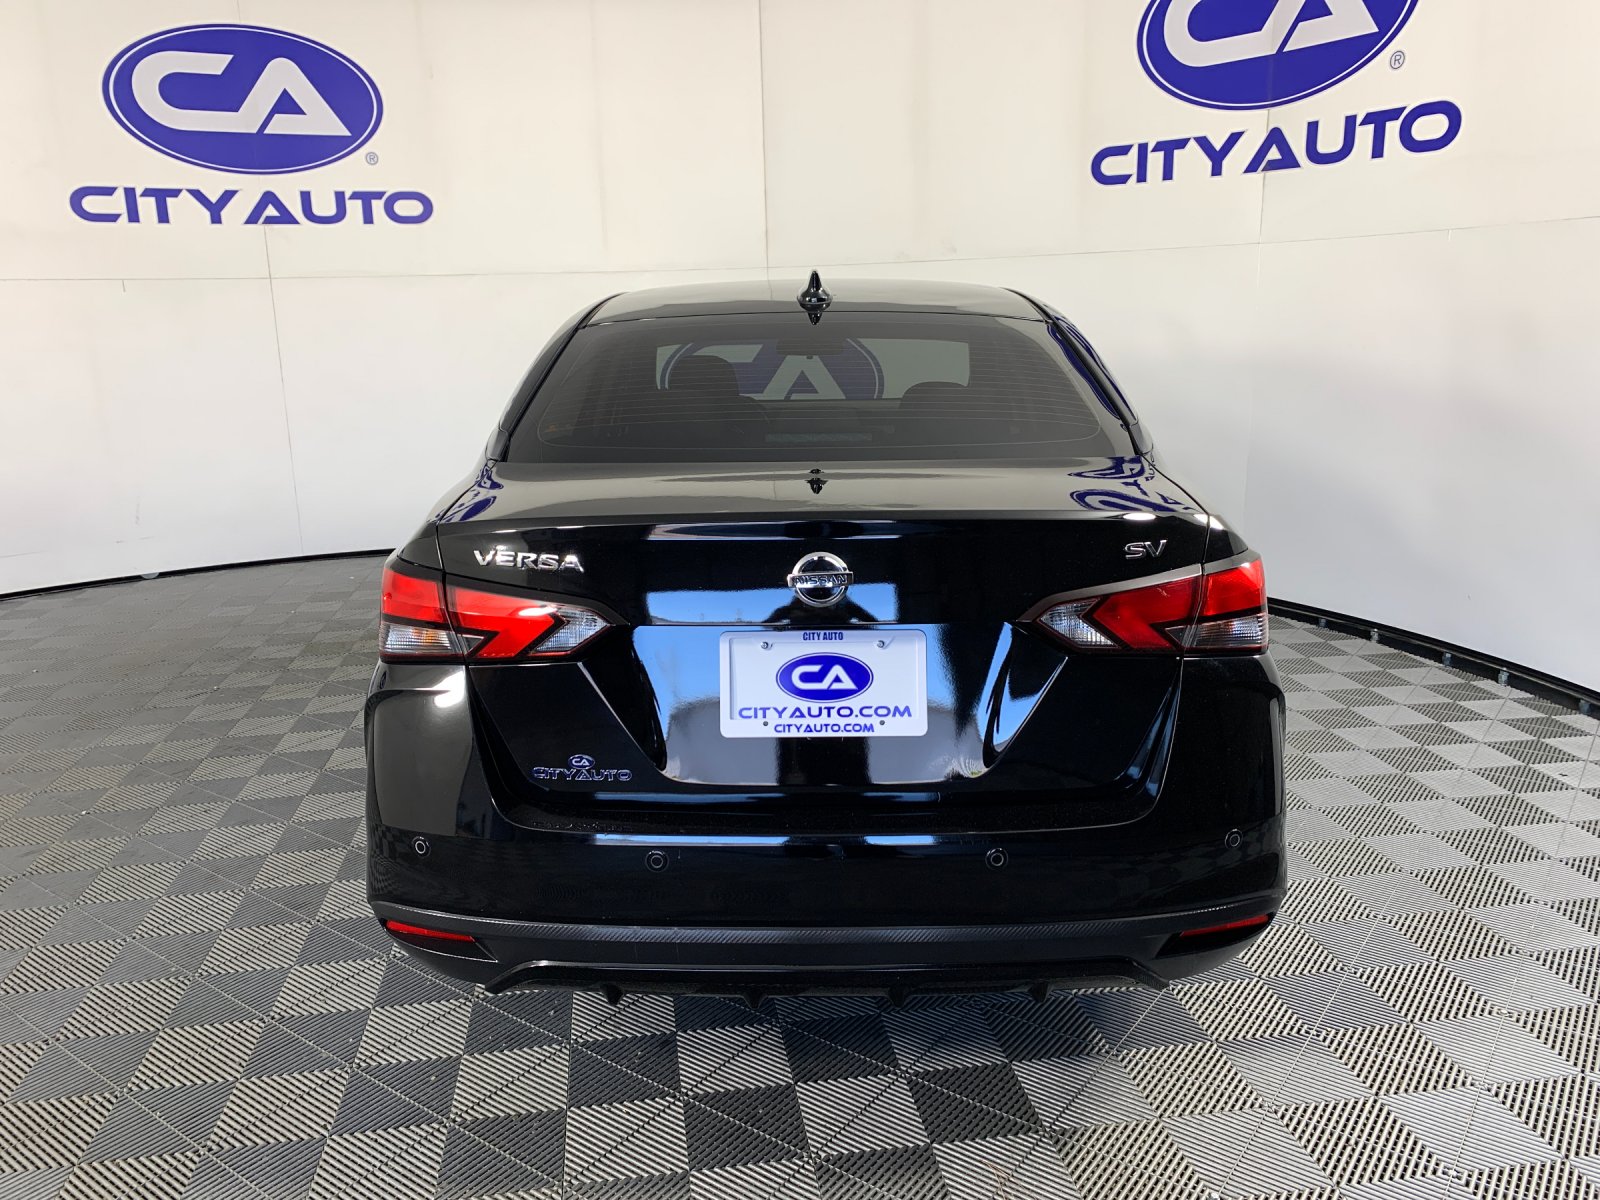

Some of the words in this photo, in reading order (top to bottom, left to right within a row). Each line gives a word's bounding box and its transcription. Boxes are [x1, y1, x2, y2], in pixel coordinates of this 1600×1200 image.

[131, 50, 353, 137] CA
[1124, 539, 1168, 560] SV
[473, 546, 585, 573] VERSA
[794, 574, 848, 586] NISSAN
[802, 631, 821, 641] CITY
[822, 631, 844, 641] AUTO
[791, 664, 859, 690] CA
[738, 705, 912, 719] CITYAUTO.COM
[774, 723, 875, 733] CITYAUTO.COM
[571, 758, 590, 766] CA
